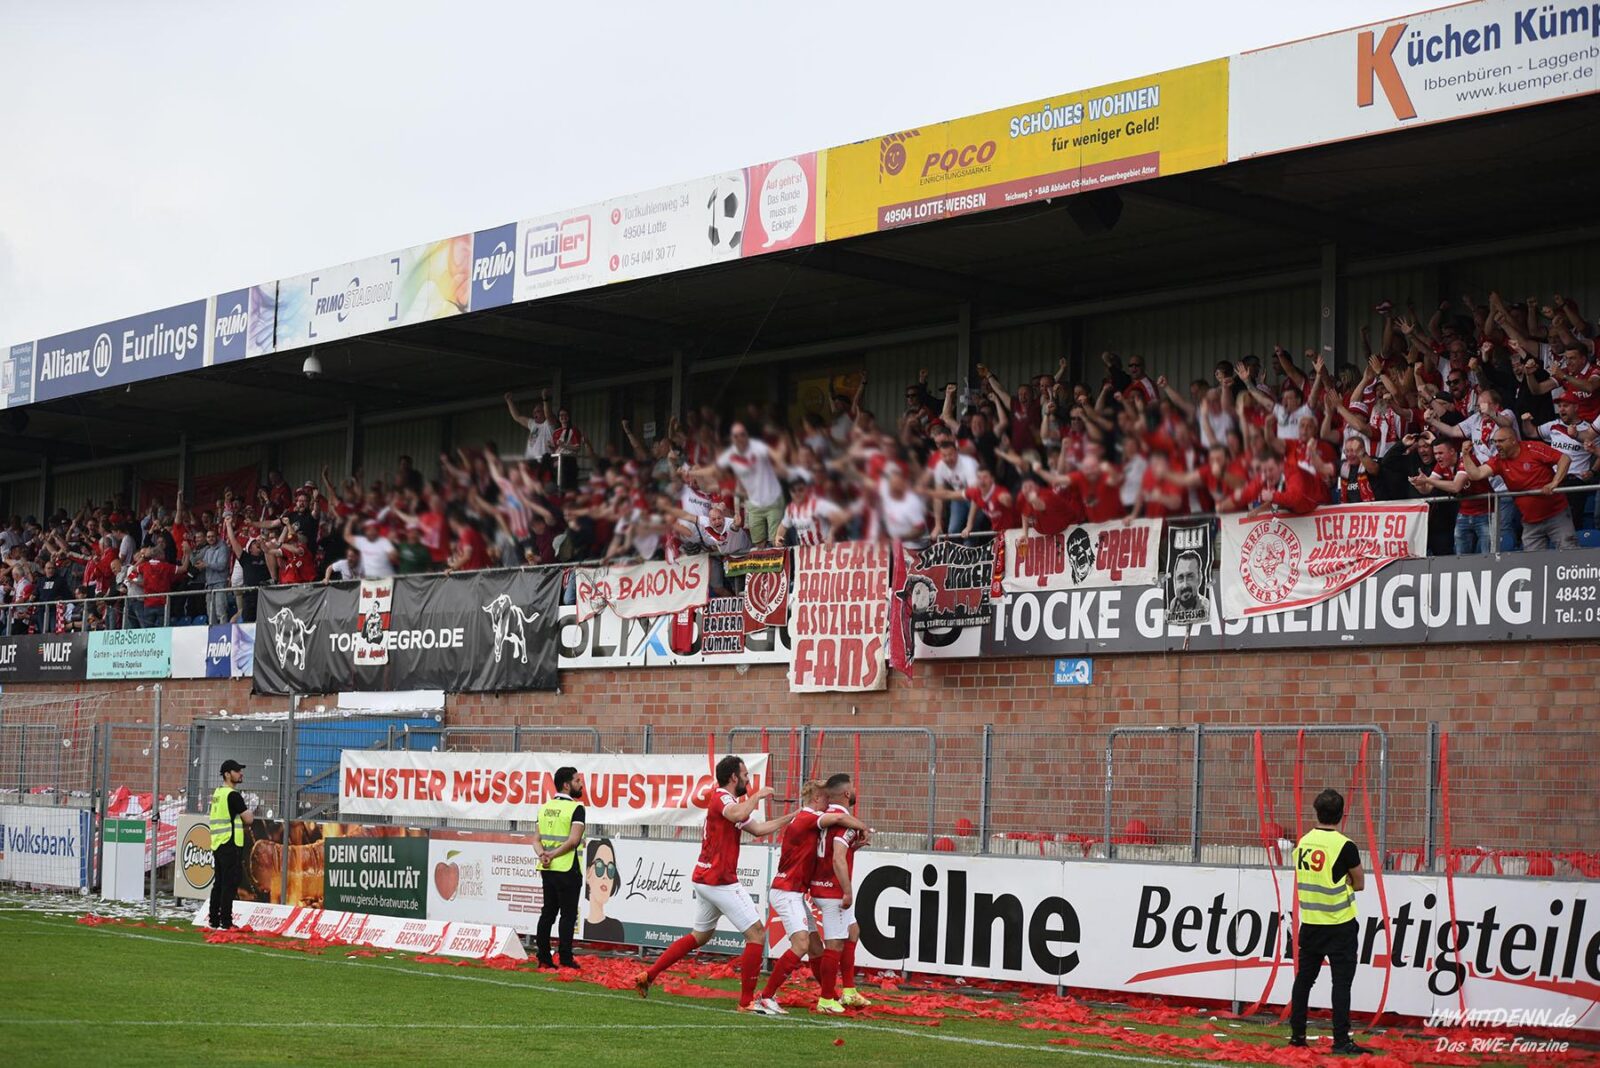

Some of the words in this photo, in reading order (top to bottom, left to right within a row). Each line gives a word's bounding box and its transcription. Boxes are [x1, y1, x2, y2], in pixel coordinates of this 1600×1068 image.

[1357, 22, 1501, 121] Küchen
[1424, 64, 1511, 91] Ibbenbüren
[1456, 66, 1593, 102] www.kuemper.de
[1010, 103, 1084, 139] SCHÖNES
[1088, 85, 1160, 121] WOHNEN
[1051, 136, 1069, 152] für
[1072, 127, 1122, 145] weniger
[1125, 116, 1160, 136] Geld!
[921, 140, 997, 178] POCO
[884, 208, 912, 223] 49504
[914, 193, 986, 219] LOTTE-WERSEN
[648, 221, 667, 236] Lotte
[530, 231, 584, 259] müller
[472, 249, 515, 282] FRIMO
[215, 311, 247, 339] FRIMO
[40, 348, 91, 382] Allianz
[121, 322, 198, 364] Eurlings
[1174, 528, 1203, 549] OLLI
[1315, 515, 1345, 541] ICH
[1348, 515, 1379, 538] BIN
[1383, 514, 1408, 538] SO
[800, 542, 888, 570] ILLEGALE
[1096, 527, 1150, 581] CREW
[1273, 524, 1299, 560] JAHRE
[1384, 541, 1408, 557] ICH
[616, 563, 701, 600] BARONS
[798, 571, 887, 603] RADIKALE
[1243, 573, 1272, 601] MEHR
[1555, 586, 1597, 601] 48432
[797, 603, 885, 635] ASOZIALE
[1555, 607, 1582, 623] Tel.:
[43, 642, 72, 662] WULFF
[208, 640, 231, 658] FRIMO
[795, 636, 882, 688] FANS
[1076, 660, 1090, 685] Q
[344, 767, 447, 801] MEISTER
[452, 768, 556, 805] MÜSSEN
[8, 825, 75, 858] Volksbank
[329, 845, 358, 863] DEIN
[360, 845, 395, 863] GRILL
[491, 867, 511, 876] LOTTE
[492, 855, 503, 864] IHR
[1297, 847, 1325, 873] K9
[329, 869, 357, 887] WILL
[360, 866, 421, 890] QUALITÄT
[855, 863, 1081, 976] Gilne
